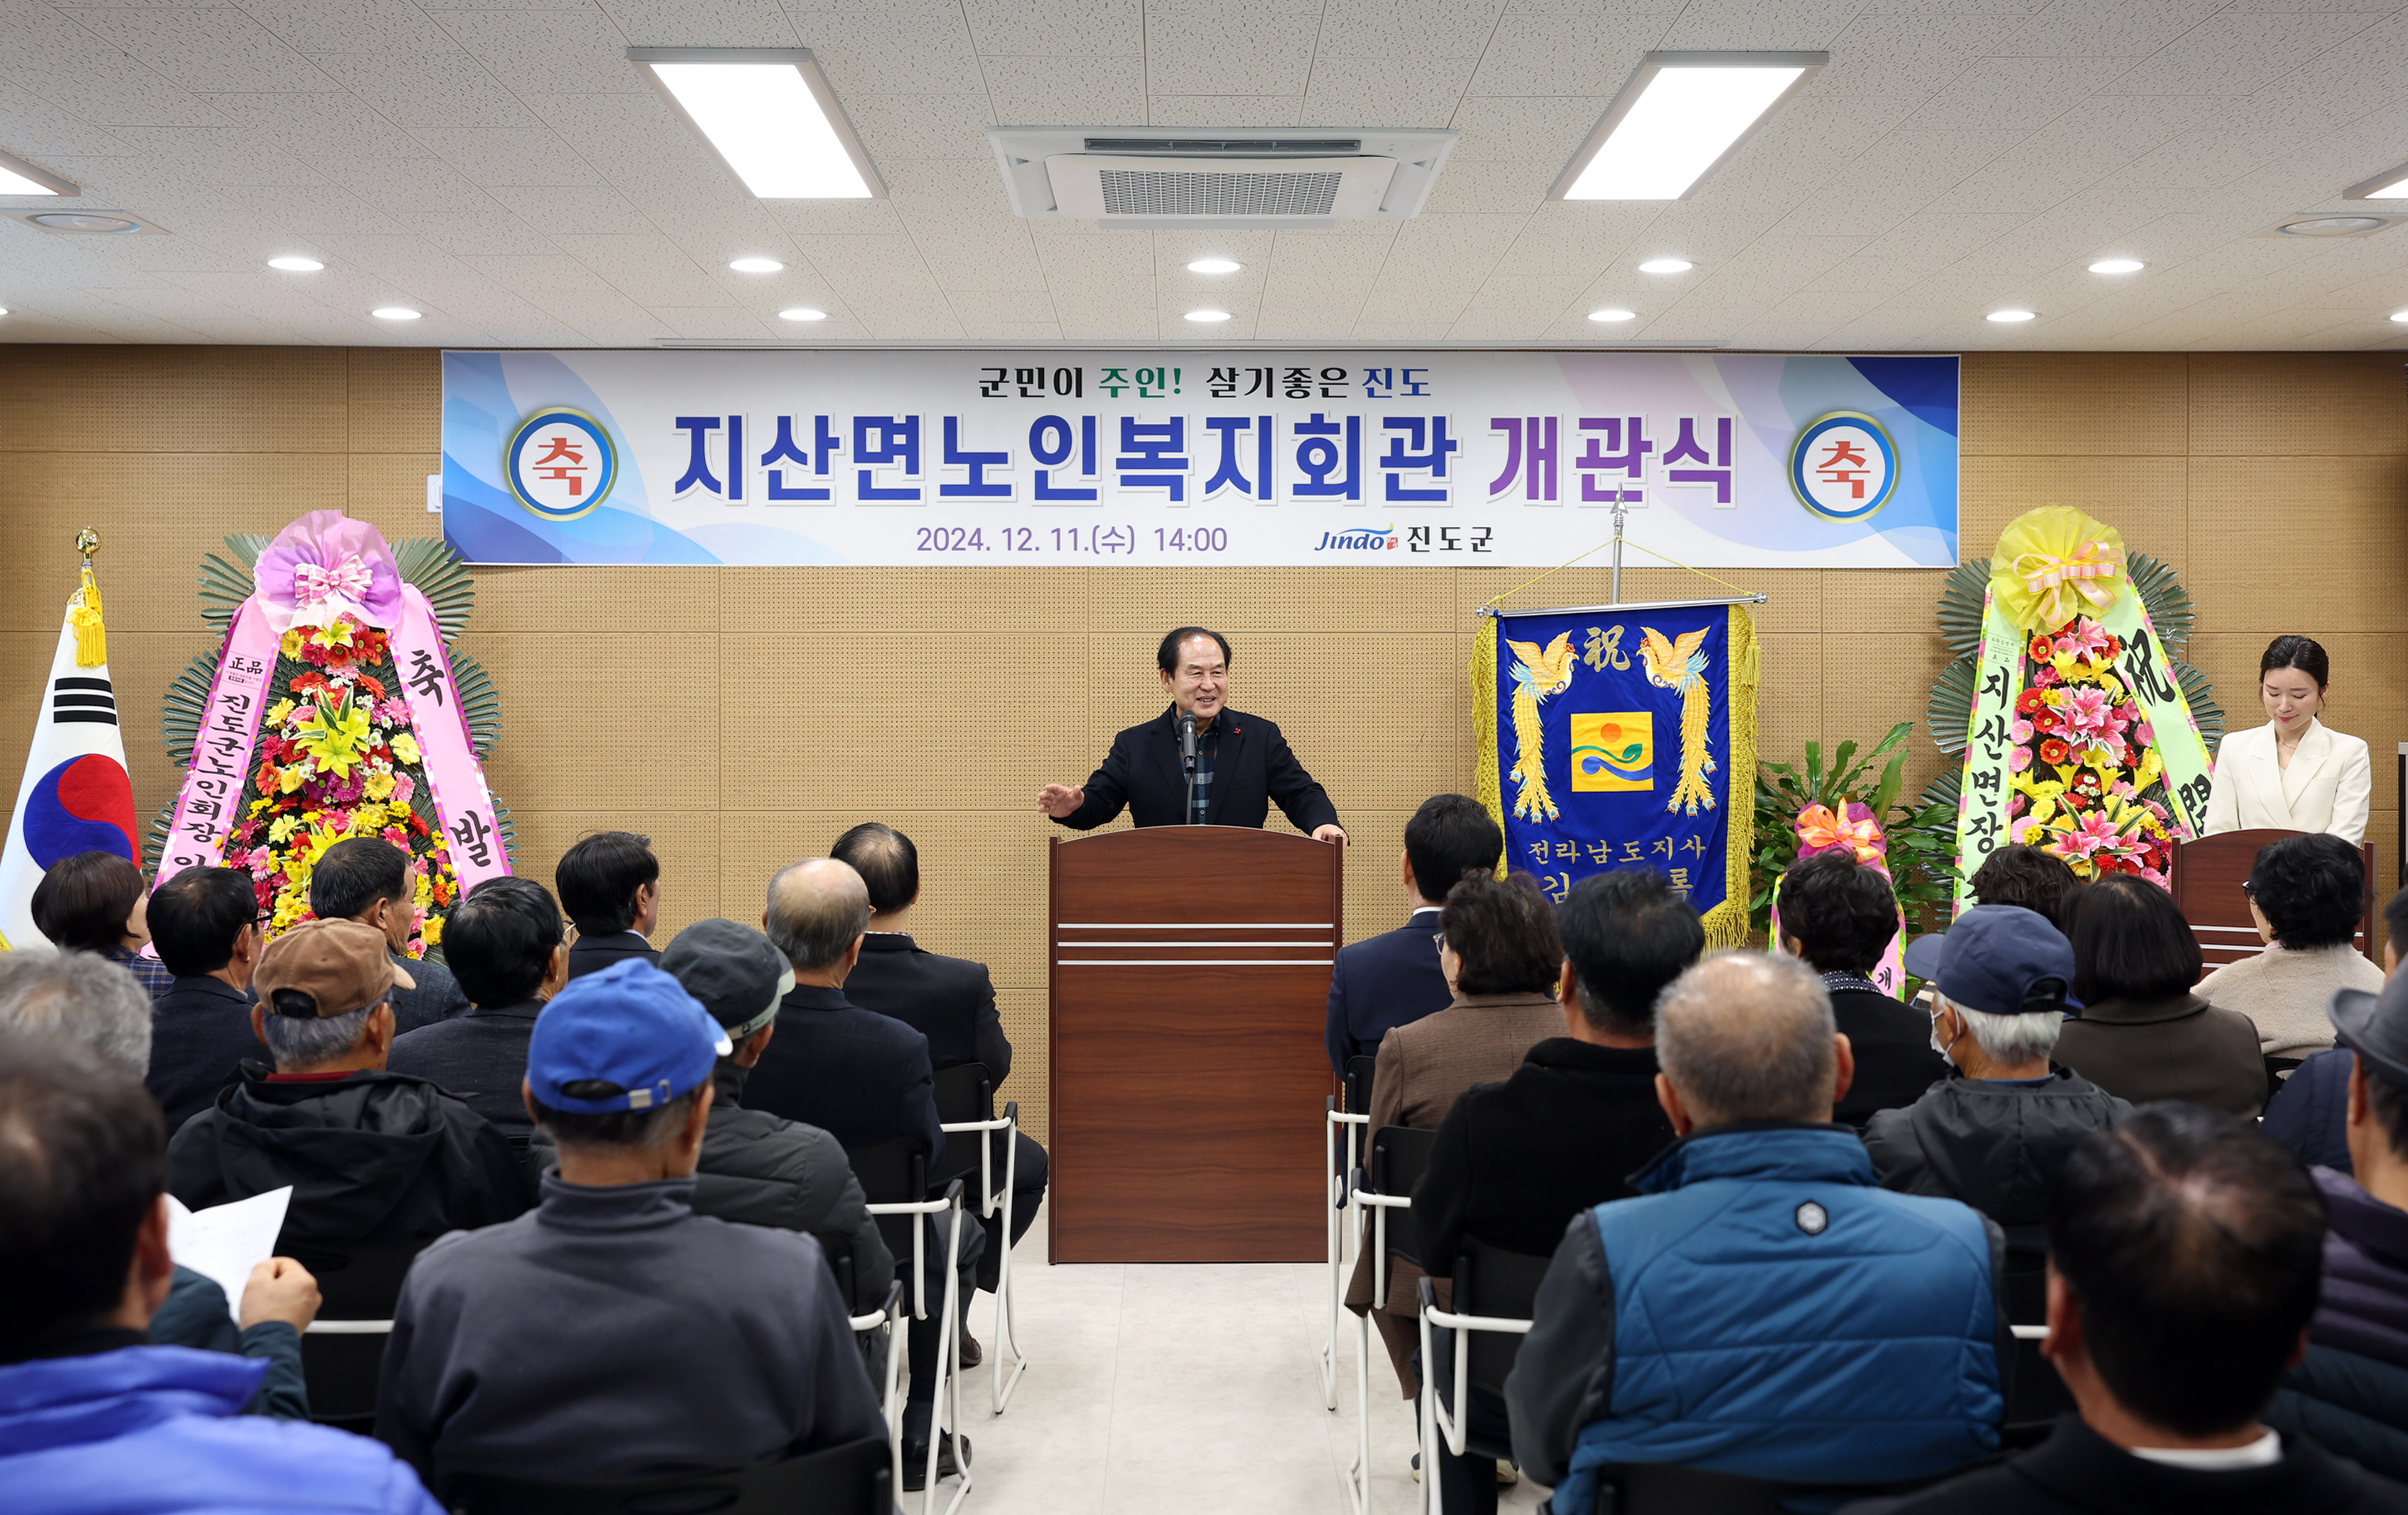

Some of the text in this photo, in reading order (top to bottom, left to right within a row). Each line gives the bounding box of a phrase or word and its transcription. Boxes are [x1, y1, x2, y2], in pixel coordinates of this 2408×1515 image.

[978, 367, 1431, 399] 군민이 주인! 살기좋은 진도
[532, 437, 589, 496] 축
[674, 413, 1732, 504] 지산면노인복지회관 개관식
[1816, 441, 1871, 499] 축
[916, 524, 1228, 554] 2024. 12. 11.(수) 14:00
[1314, 532, 1384, 551] Jindo
[1407, 526, 1493, 553] 진도군
[228, 657, 263, 675] 正品
[1583, 624, 1631, 672] 祝
[2117, 628, 2176, 707] 祝
[180, 694, 250, 843] 진도군노인회장
[408, 649, 491, 867] 축 발
[1964, 666, 2012, 854] 지산면장
[1528, 835, 1707, 865] 전라남도지사
